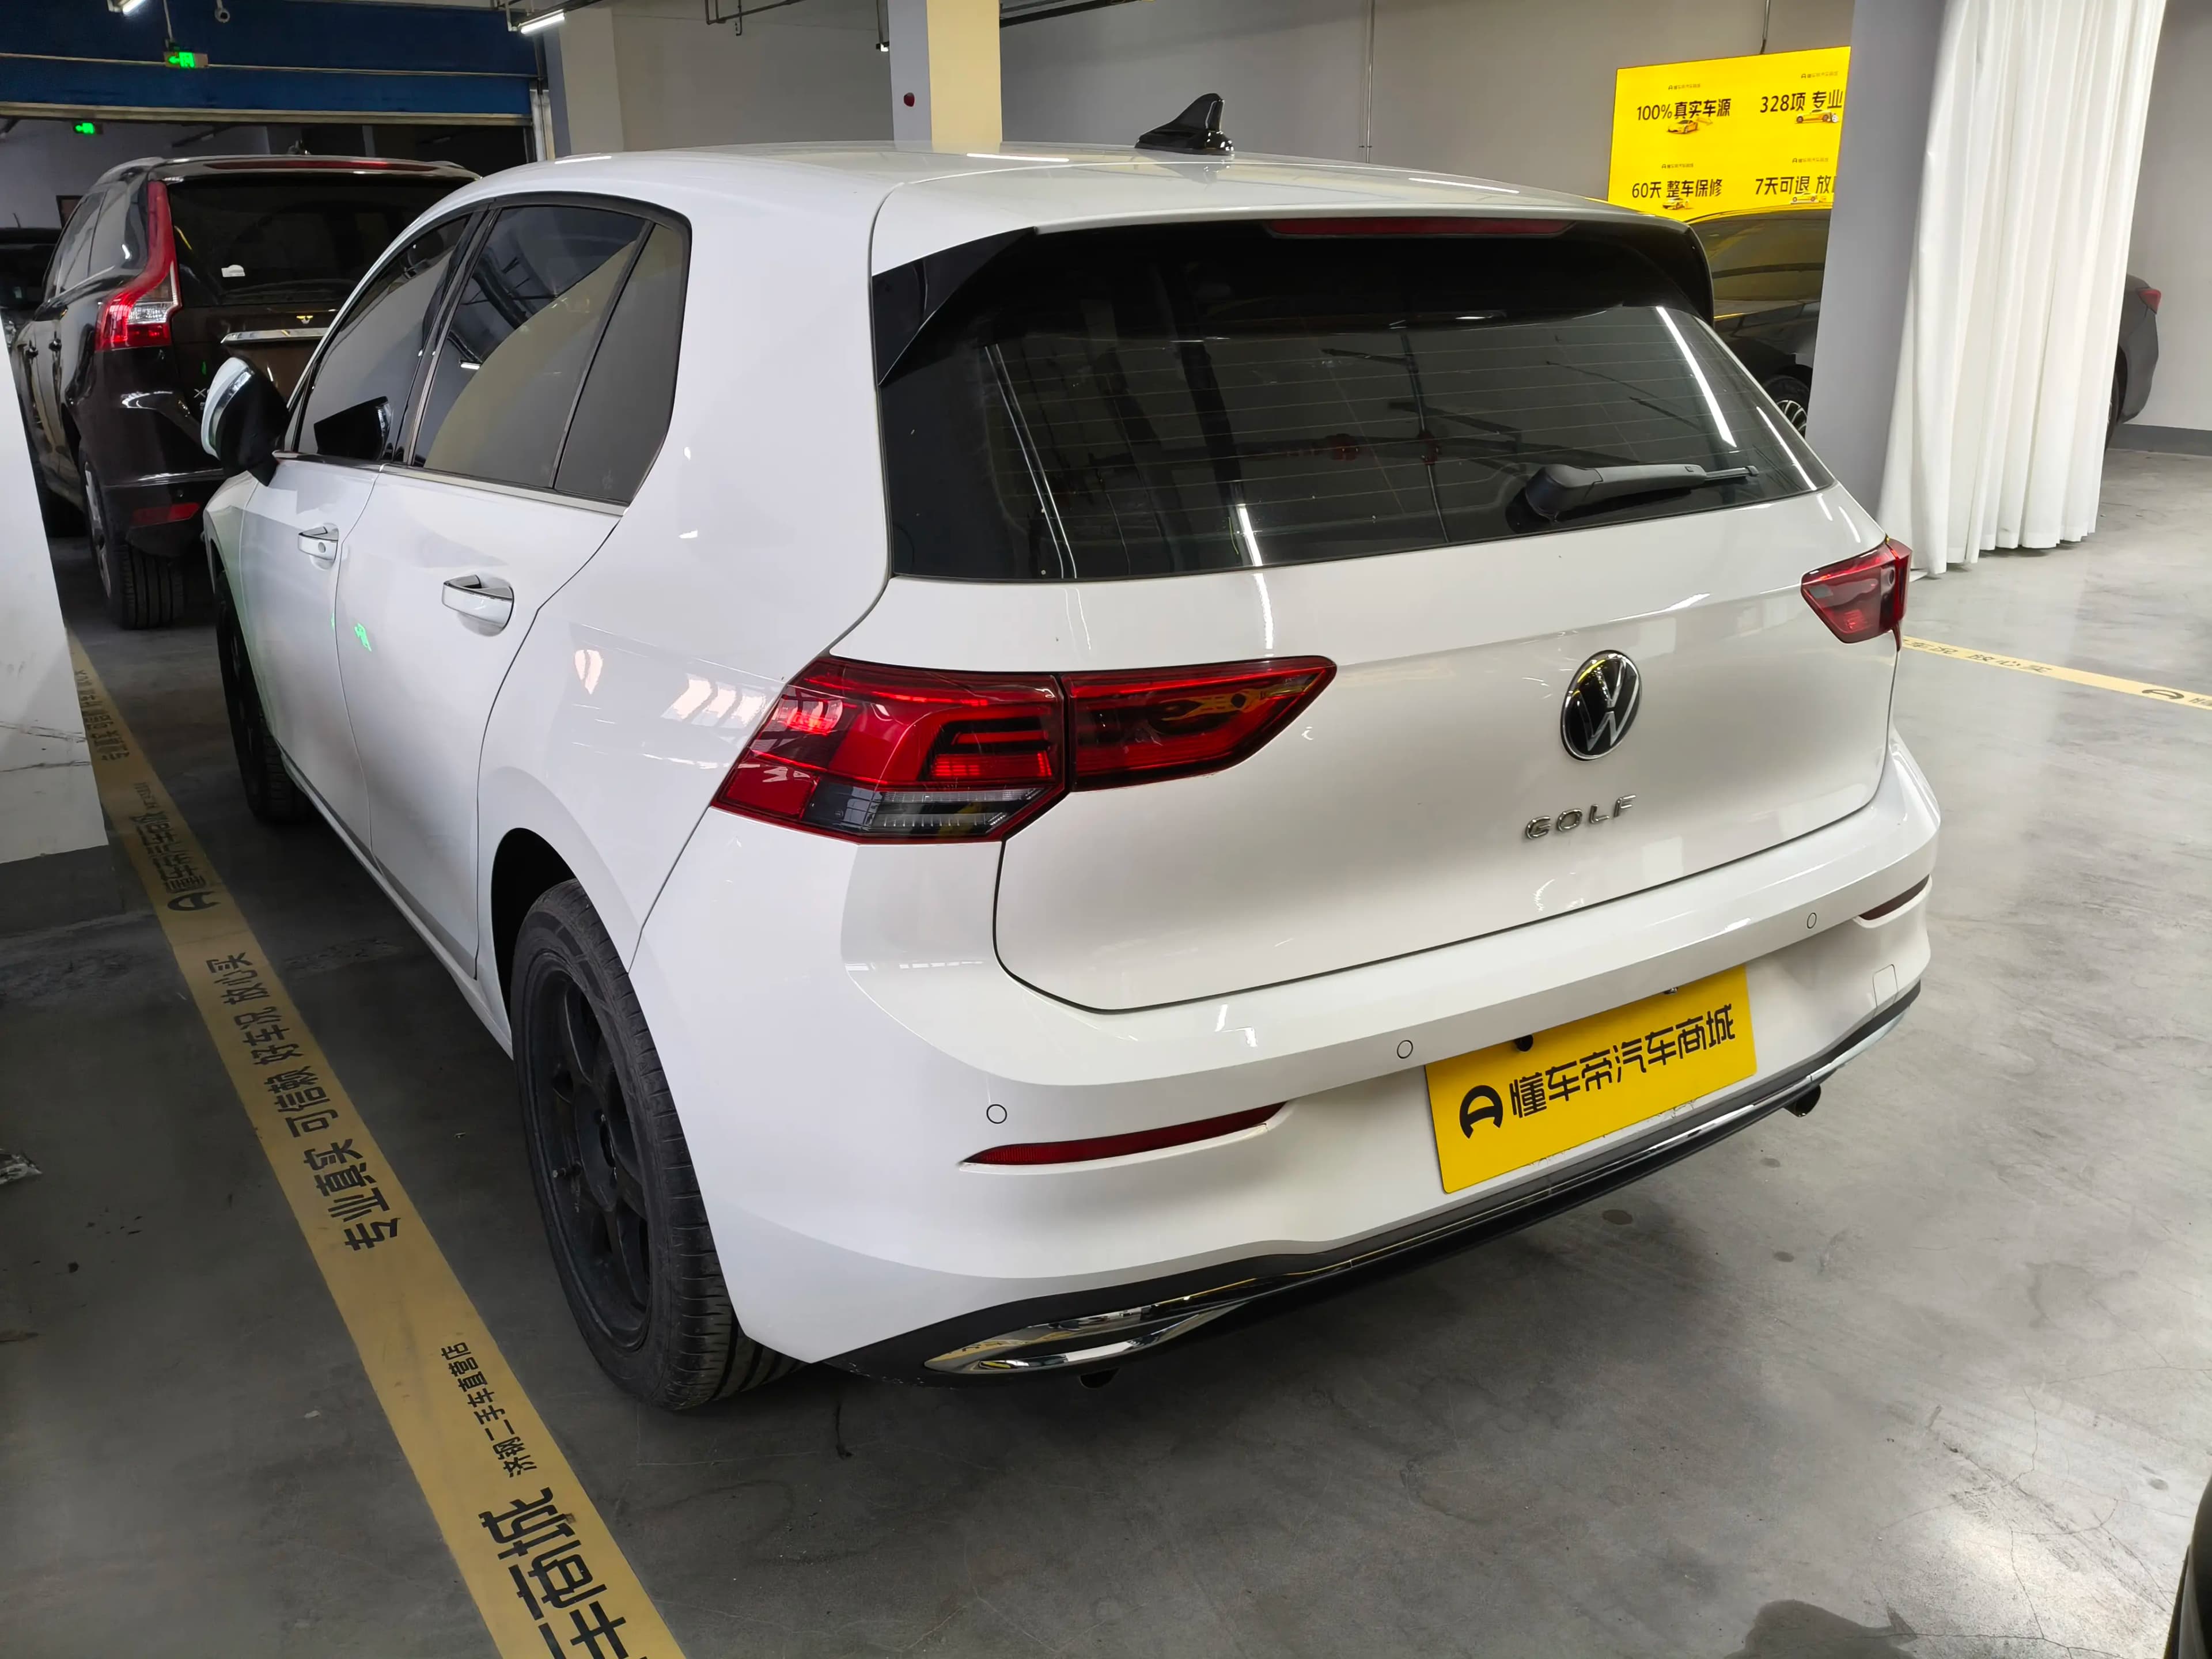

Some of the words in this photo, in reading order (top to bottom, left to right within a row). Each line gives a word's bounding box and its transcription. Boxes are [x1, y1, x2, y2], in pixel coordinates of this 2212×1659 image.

[1760, 92, 1806, 113] 328项
[1812, 89, 1843, 109] 专业
[1632, 181, 1662, 199] 60天
[1666, 179, 1722, 198] 整车保修
[1755, 175, 1810, 195] 7天可退
[1815, 175, 1836, 194] 放
[1525, 794, 1637, 839] GOLF
[233, 1006, 305, 1066] 好车况
[1509, 1003, 1736, 1119] 懂车帝汽车商城
[263, 1065, 339, 1138] 可信赖
[303, 1138, 402, 1251] 专业真实
[441, 1342, 538, 1478] 济钢二手车直营店
